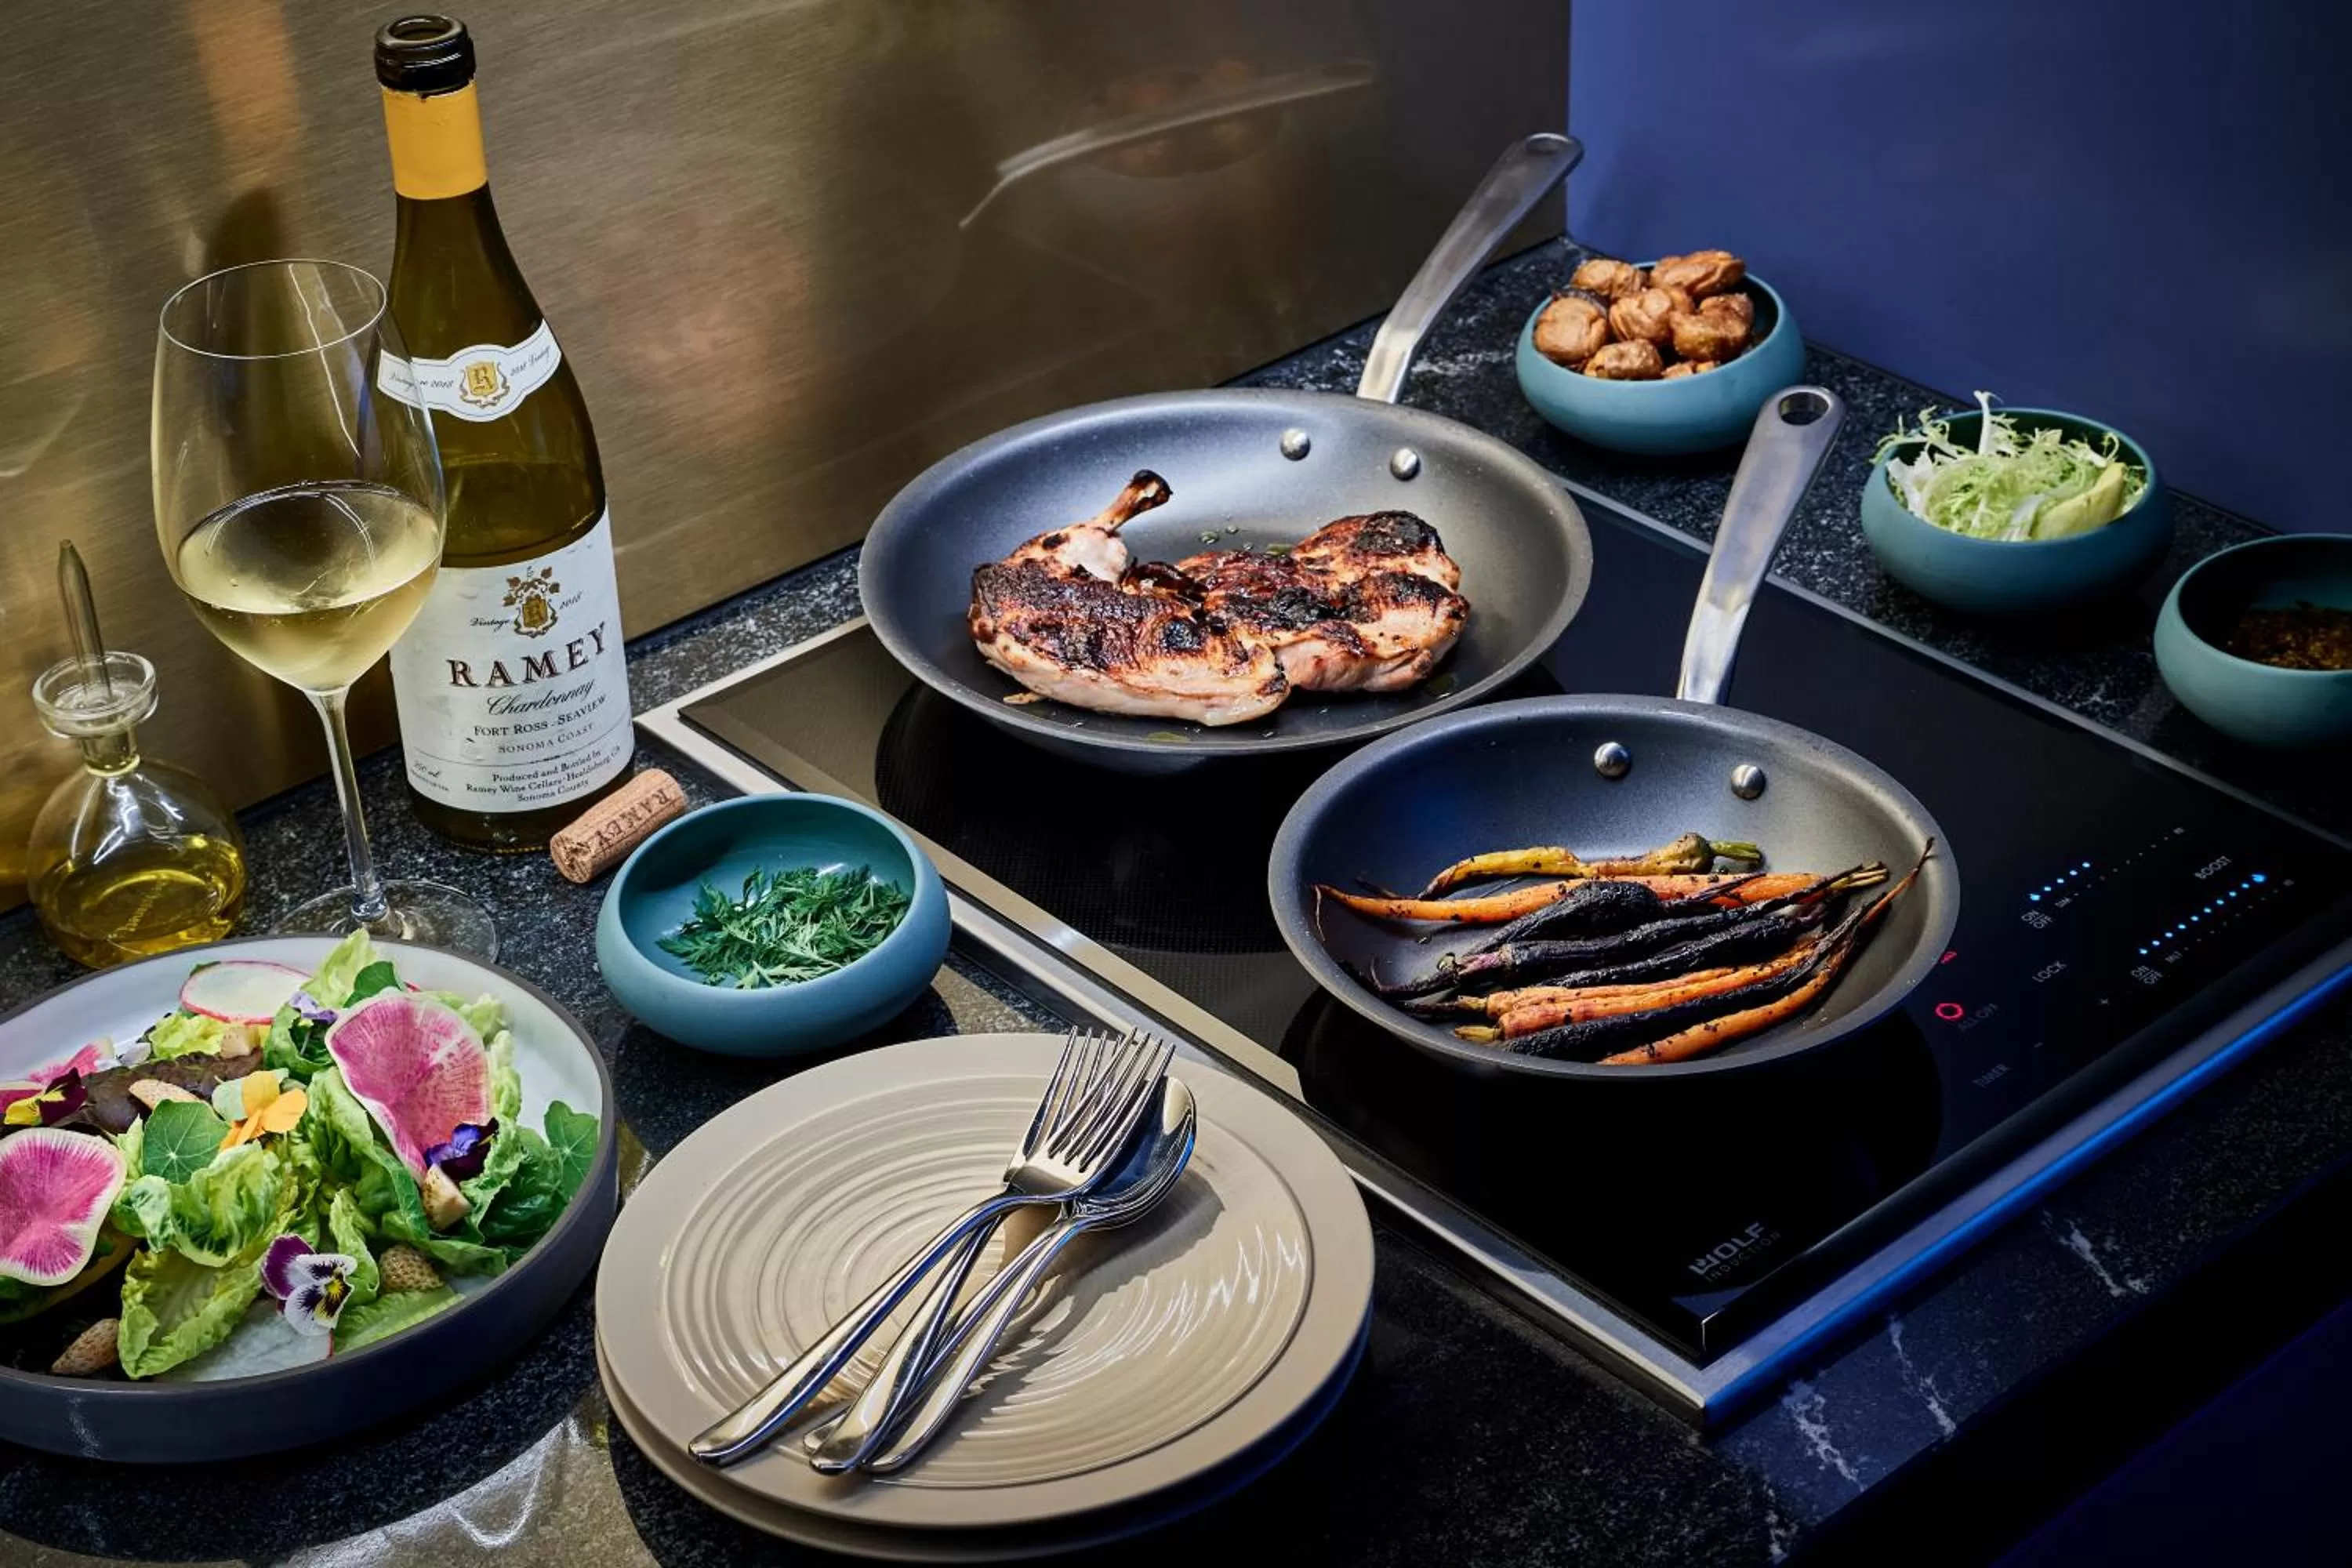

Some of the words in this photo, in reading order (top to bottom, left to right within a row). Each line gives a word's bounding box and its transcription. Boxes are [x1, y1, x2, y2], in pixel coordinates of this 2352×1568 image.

[470, 616, 510, 633] Vintage
[446, 621, 606, 688] RAMEY
[487, 679, 595, 716] Chardonnay
[474, 725, 510, 737] FORT
[498, 739, 555, 754] SONOMA
[557, 723, 595, 744] COAST
[492, 770, 539, 782] Produced
[541, 766, 559, 777] and
[561, 755, 592, 772] Bottled
[466, 783, 497, 794] Ramey
[499, 784, 526, 793] Wine
[517, 791, 556, 802] Sonoma
[557, 779, 589, 794] County
[592, 788, 671, 848] RAMEY
[2193, 855, 2233, 880] BOOST
[2020, 909, 2039, 921] ON
[2033, 915, 2053, 929] OFF
[2032, 960, 2068, 983] LOCK
[1687, 1221, 1765, 1276] WOLF
